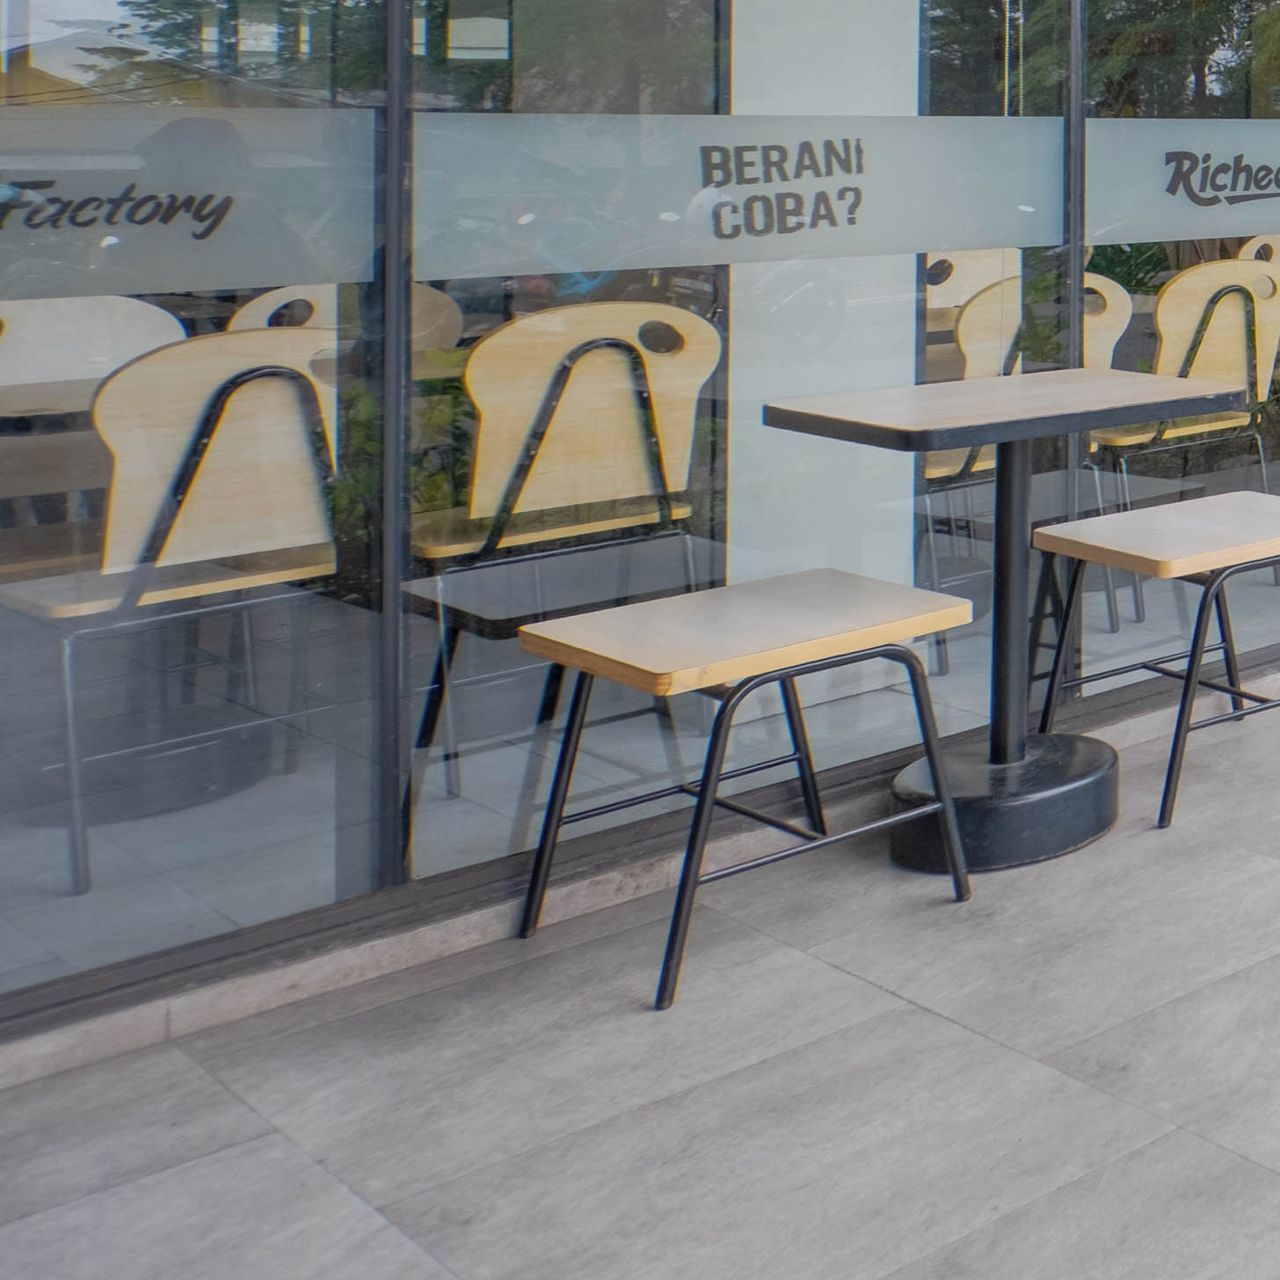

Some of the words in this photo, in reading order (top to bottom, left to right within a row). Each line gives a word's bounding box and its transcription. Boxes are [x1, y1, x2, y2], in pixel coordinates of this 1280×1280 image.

[700, 138, 863, 188] BERANI
[0, 180, 234, 240] Factory
[711, 186, 862, 239] COBA?
